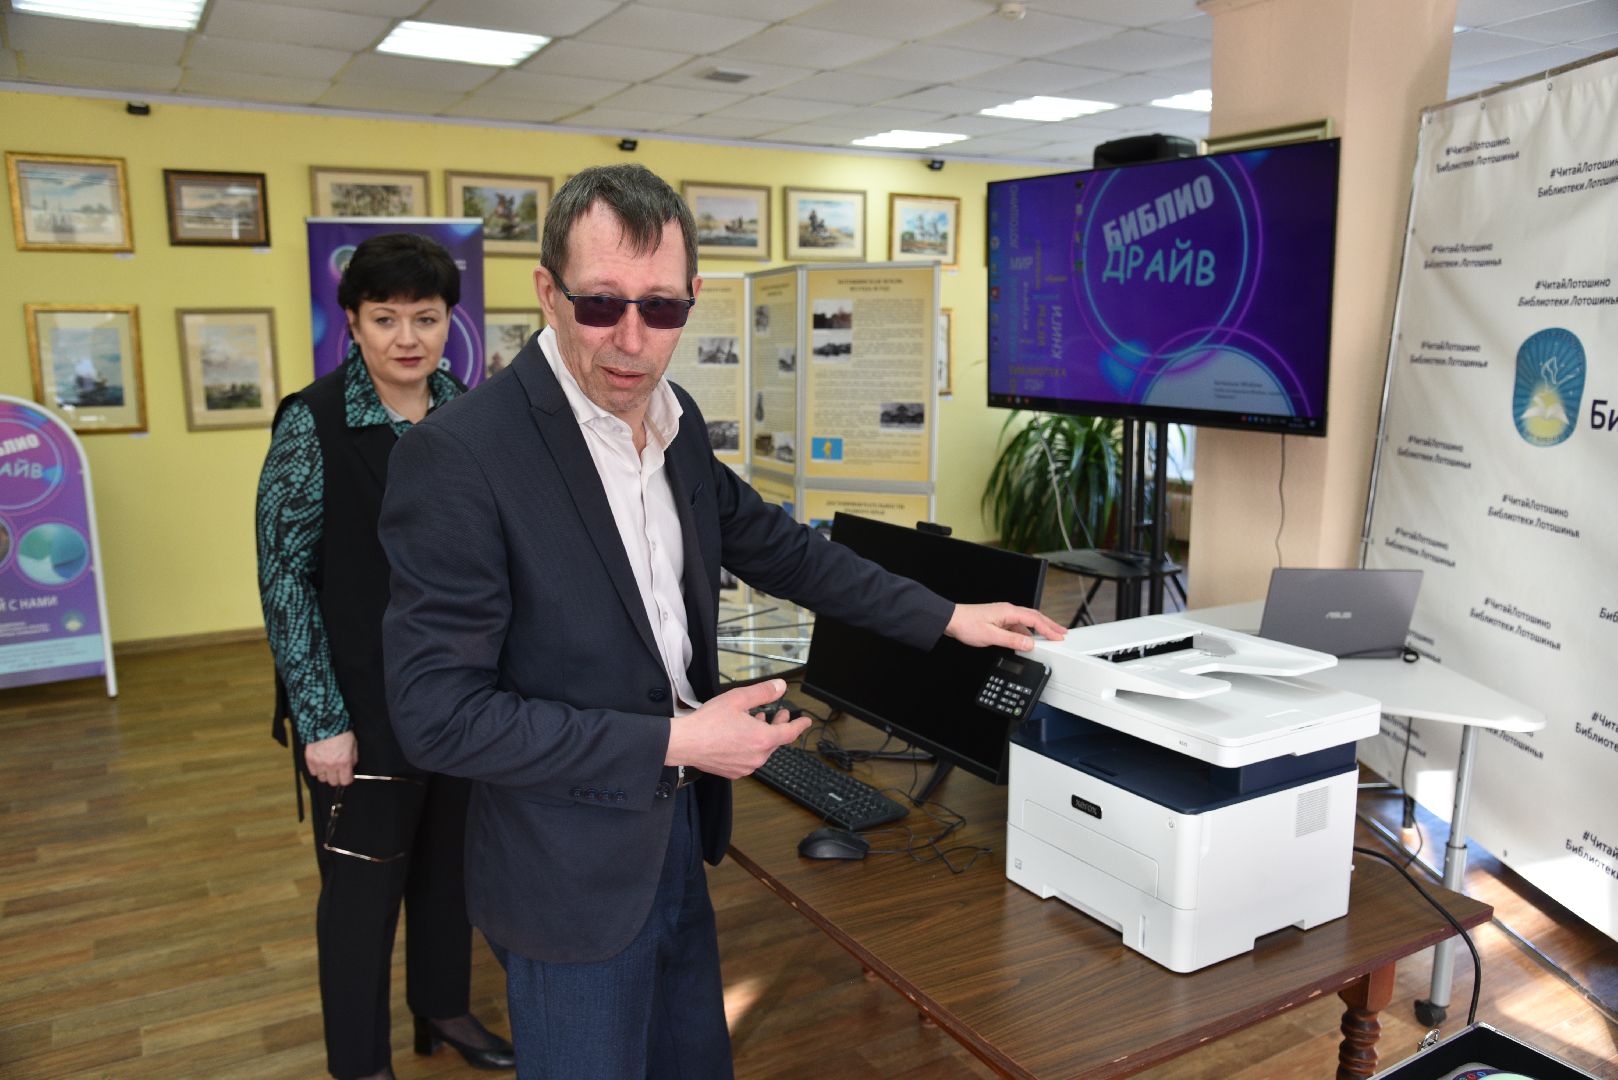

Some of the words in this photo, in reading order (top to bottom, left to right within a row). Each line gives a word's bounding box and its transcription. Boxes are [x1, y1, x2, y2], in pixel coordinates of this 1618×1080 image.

[1538, 183, 1584, 198] Библиотеки
[1102, 174, 1215, 251] БИБЛИО
[1102, 238, 1216, 287] ДРАЙВ
[1535, 278, 1611, 290] #ЧитайЛотошино
[1518, 296, 1570, 306] Библиотеки
[1051, 304, 1062, 360] КНИГИ
[1488, 506, 1534, 526] Библиотеки
[1535, 518, 1580, 538] Лотошинья
[1502, 494, 1569, 518] #ЧитайЛотошино
[1470, 607, 1515, 632] Библиотеки
[1515, 625, 1560, 650] Лотошинья
[1484, 597, 1551, 629] #ЧитайЛотошино
